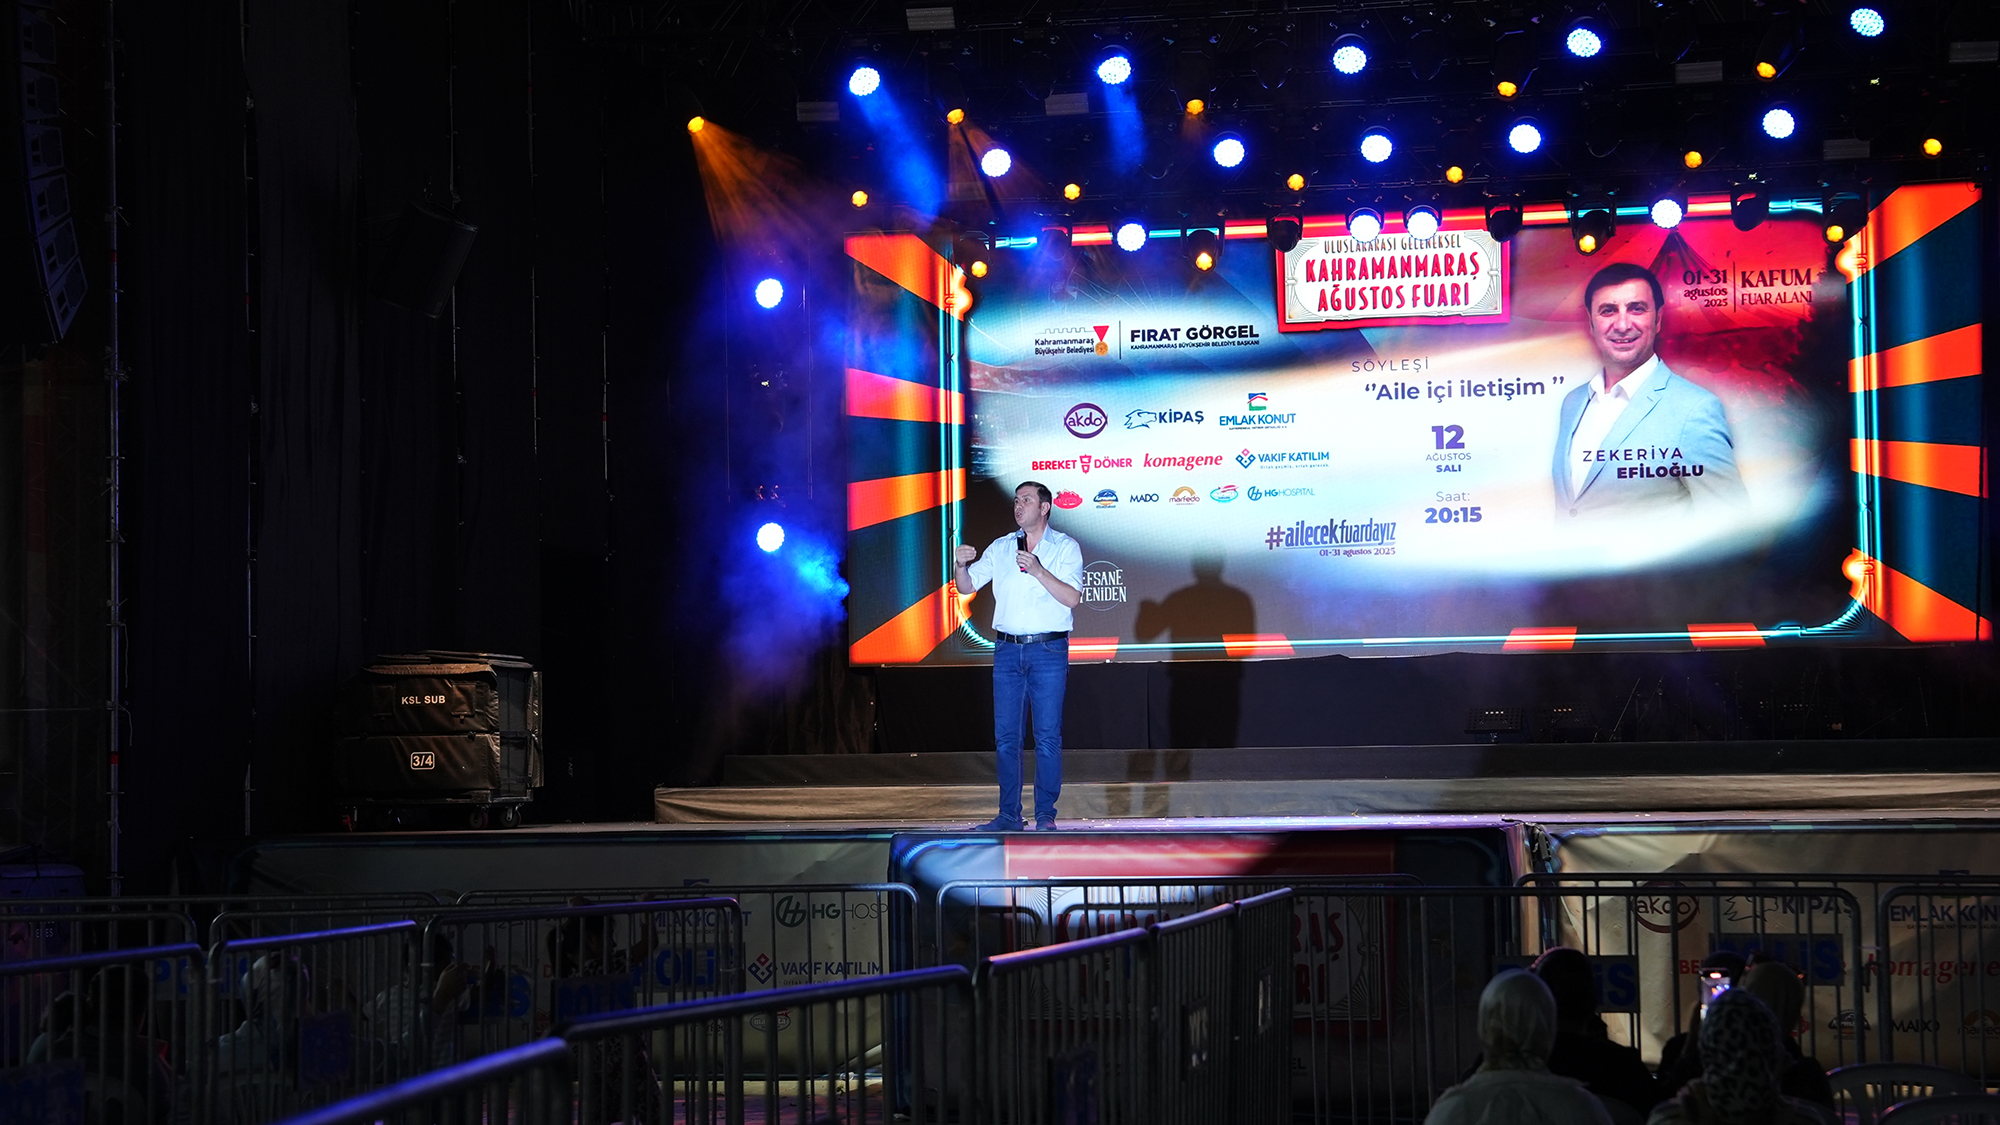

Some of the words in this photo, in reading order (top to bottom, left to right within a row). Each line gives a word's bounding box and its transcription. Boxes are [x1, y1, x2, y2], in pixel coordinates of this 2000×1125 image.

[1306, 252, 1481, 282] KAHRAMANMARAŞ
[1682, 269, 1727, 285] 01-31
[1741, 268, 1812, 288] KAFUM
[1318, 284, 1405, 312] AĞUSTOS
[1412, 282, 1469, 308] FUARI
[1704, 299, 1728, 307] 2025
[1035, 337, 1094, 346] Kahramanmaraş
[1130, 328, 1181, 342] FIRAT
[1186, 324, 1259, 340] GÖRGEL
[1351, 356, 1429, 373] SÖYLEŞİ
[1427, 380, 1452, 403] içi
[1460, 377, 1545, 401] iletişim
[1068, 411, 1102, 428] akdo
[1159, 408, 1204, 425] KİPAŞ
[1219, 414, 1257, 426] EMLAK
[1258, 413, 1296, 425] KONUT
[1431, 424, 1465, 449] 12
[1143, 453, 1223, 471] komagene
[1258, 452, 1286, 463] VAKIF
[1287, 451, 1330, 462] KATILIM
[1425, 452, 1472, 461] AĞUSTOS
[1582, 445, 1683, 462] ZEKERİYA
[1032, 459, 1077, 471] BEREKET
[1094, 456, 1133, 469] DÖNER
[1436, 464, 1461, 472] SALI
[1617, 462, 1704, 479] EFİLOĞLU
[1130, 493, 1159, 503] MADO
[1436, 491, 1470, 502] Saat:
[1424, 506, 1482, 524] 20:15
[1265, 517, 1396, 550] #ailecekfuardayız
[1319, 548, 1341, 557] 01-31
[1374, 547, 1396, 556] 2025
[1082, 569, 1123, 586] EFSANE
[401, 696, 421, 705] KSL
[424, 695, 446, 704] SUB
[412, 755, 433, 767] 3/4
